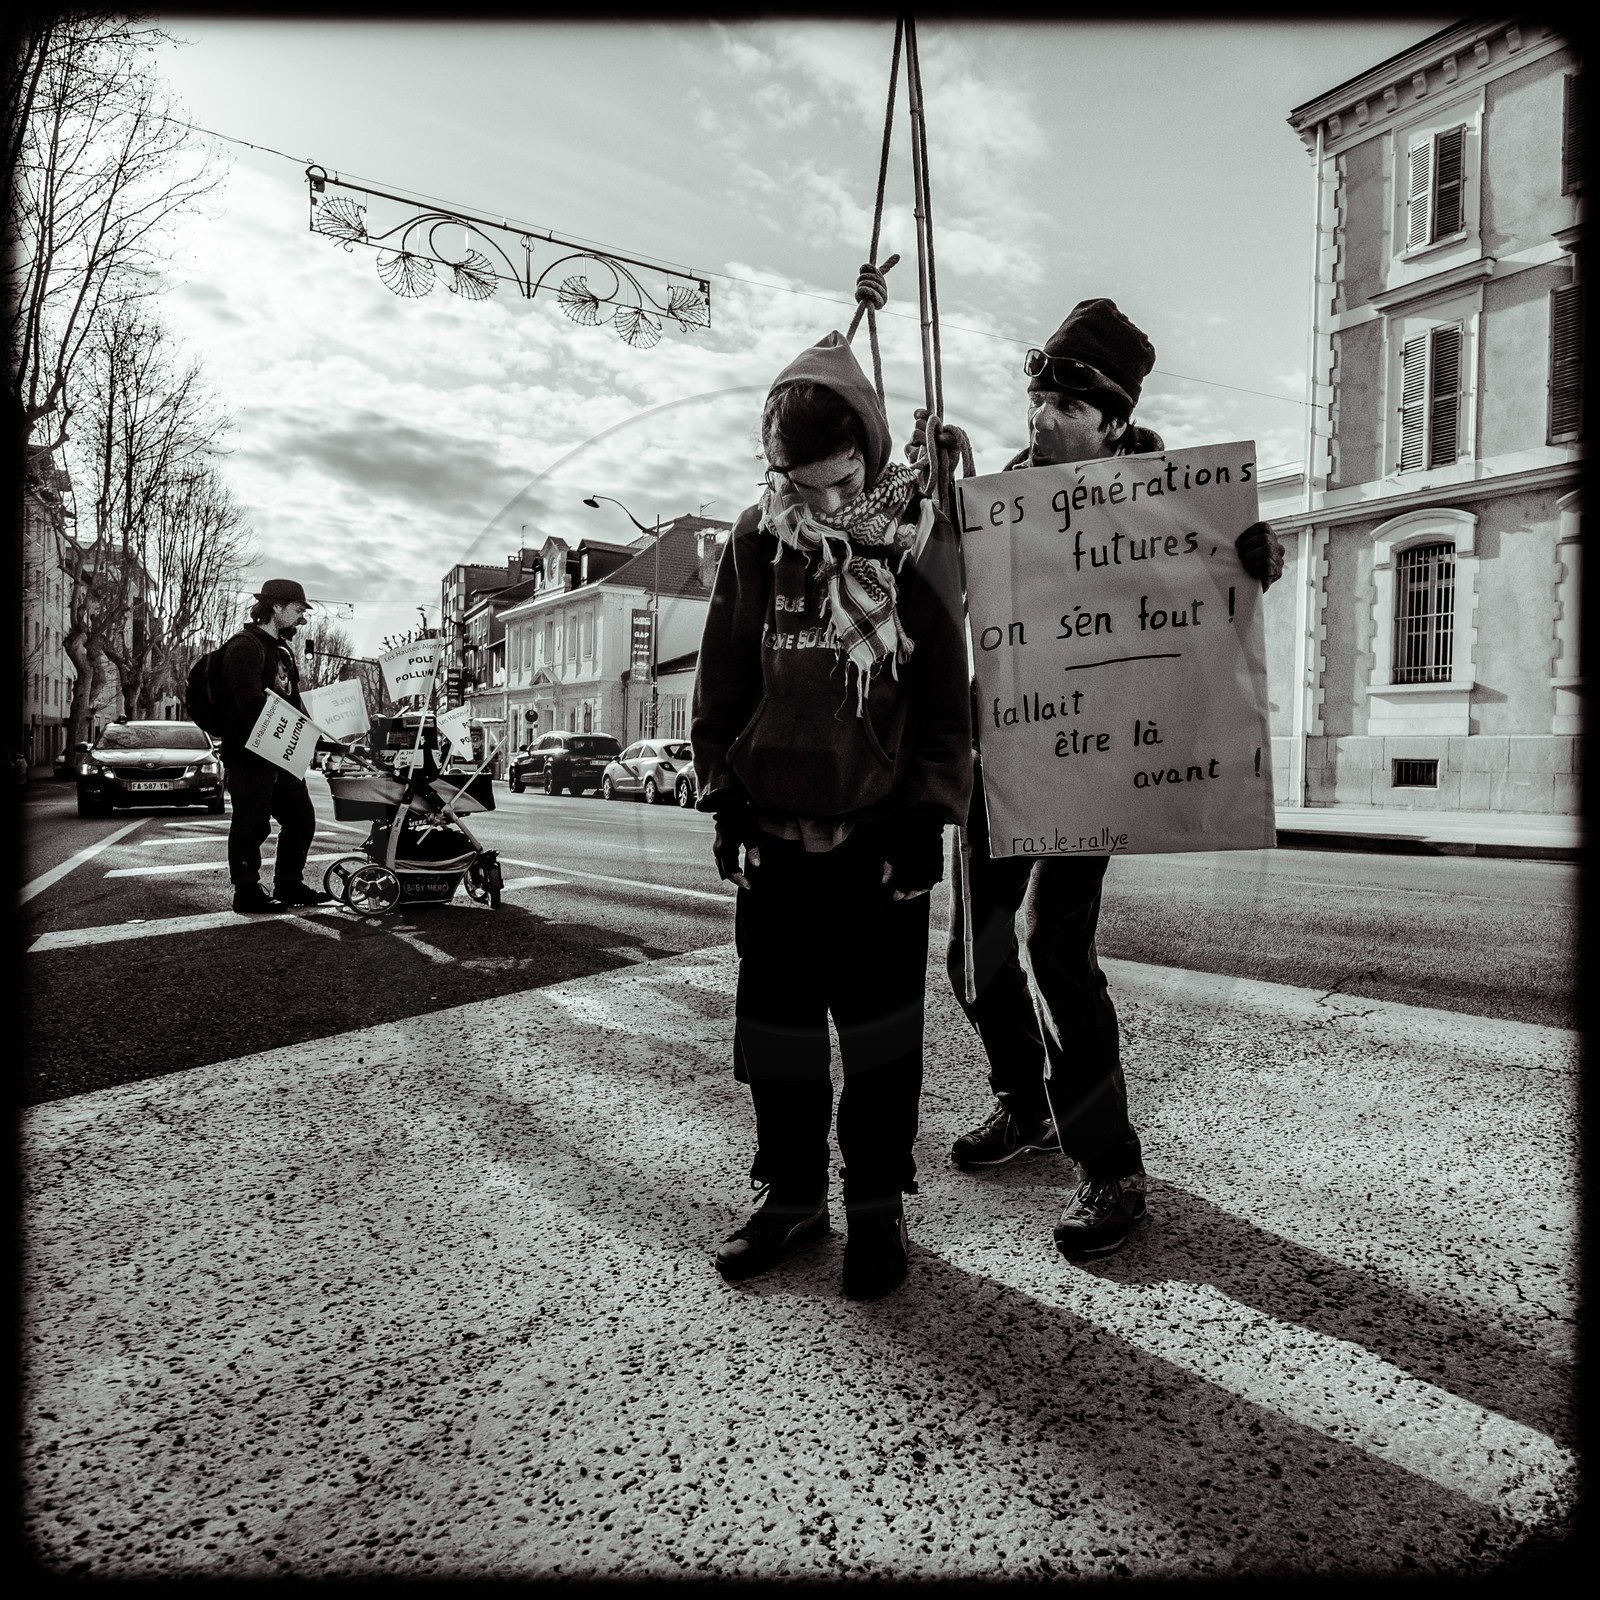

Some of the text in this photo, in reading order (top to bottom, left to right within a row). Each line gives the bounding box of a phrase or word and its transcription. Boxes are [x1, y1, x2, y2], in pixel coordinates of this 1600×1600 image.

[958, 462, 1254, 533] Les générations
[979, 621, 1028, 651] on
[1138, 595, 1205, 632] fout
[408, 655, 434, 666] POLE
[272, 716, 288, 740] POLE
[992, 690, 1085, 728] fallait
[251, 737, 262, 749] Les
[282, 716, 308, 762] POLLUTION
[1054, 718, 1164, 758] être là
[1133, 758, 1220, 789] avant
